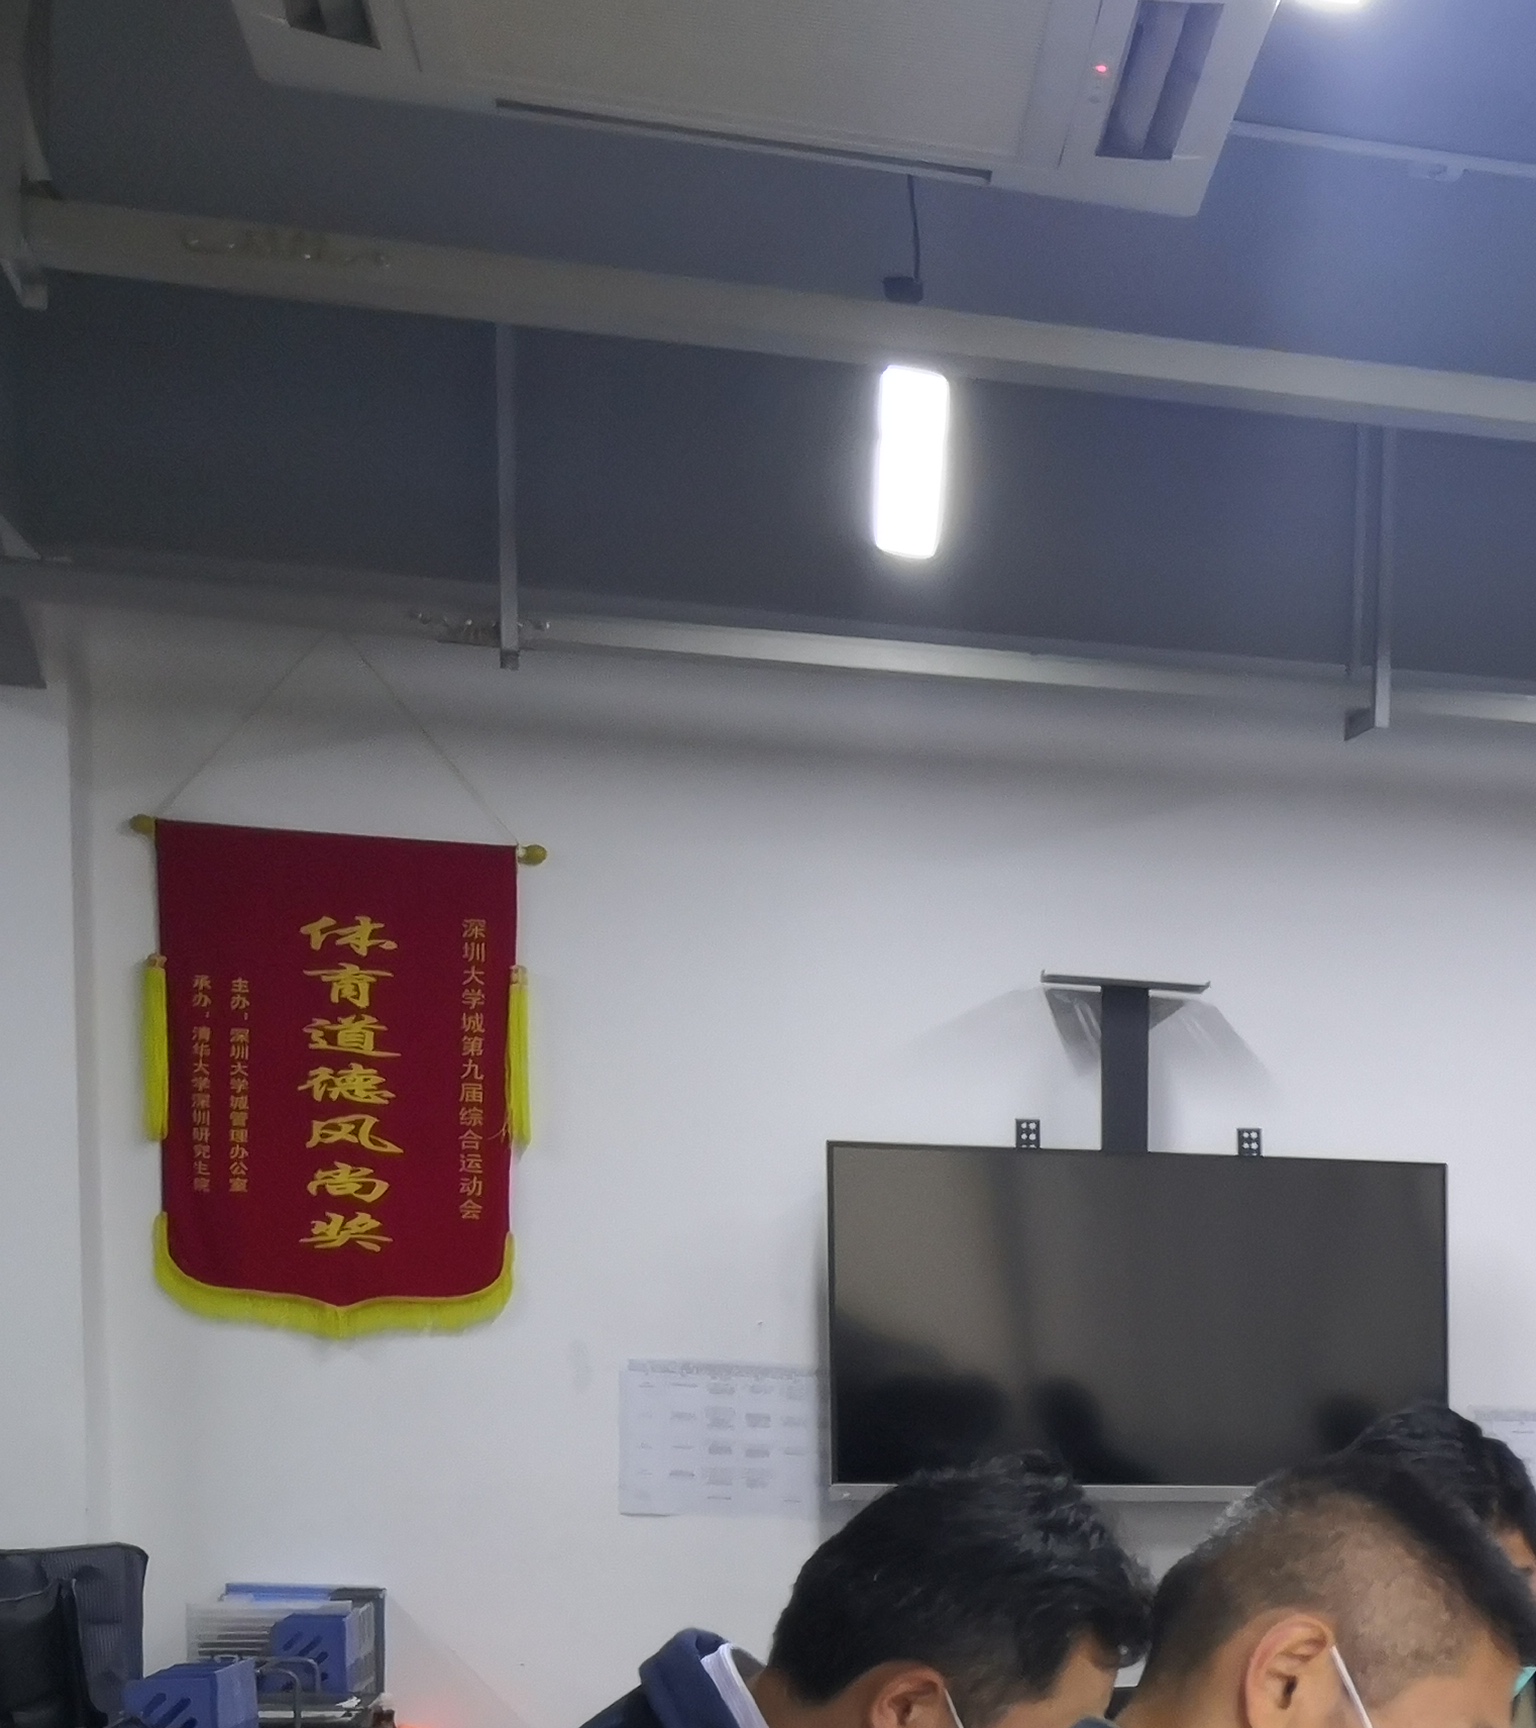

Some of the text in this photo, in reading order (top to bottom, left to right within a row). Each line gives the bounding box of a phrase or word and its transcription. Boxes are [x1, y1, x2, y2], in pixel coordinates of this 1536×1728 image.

[296, 915, 404, 1253] 体育道德风尚奖
[458, 917, 488, 1221] 深圳大学城第九届综合运动会
